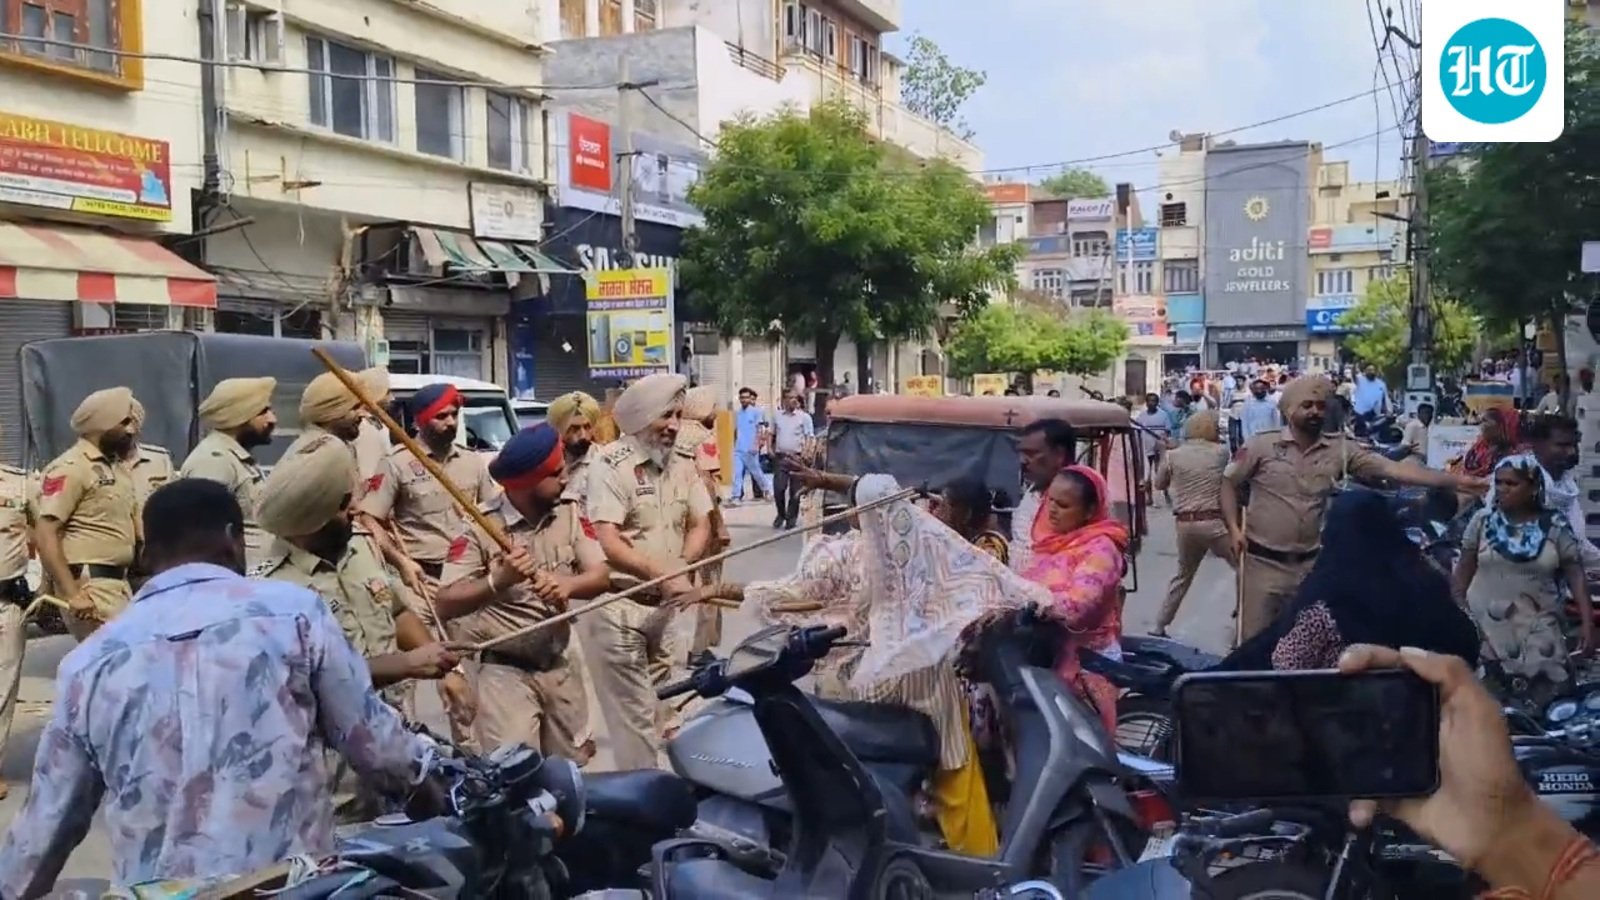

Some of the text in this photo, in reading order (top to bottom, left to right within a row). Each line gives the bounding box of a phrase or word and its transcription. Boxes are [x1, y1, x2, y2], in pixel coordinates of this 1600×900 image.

[0, 119, 51, 143] ABH
[1229, 236, 1285, 262] aditi
[1237, 266, 1275, 278] GOLD
[1223, 280, 1291, 293] JEWELLERS
[1541, 773, 1590, 782] HERO
[1538, 782, 1594, 791] HONDA
